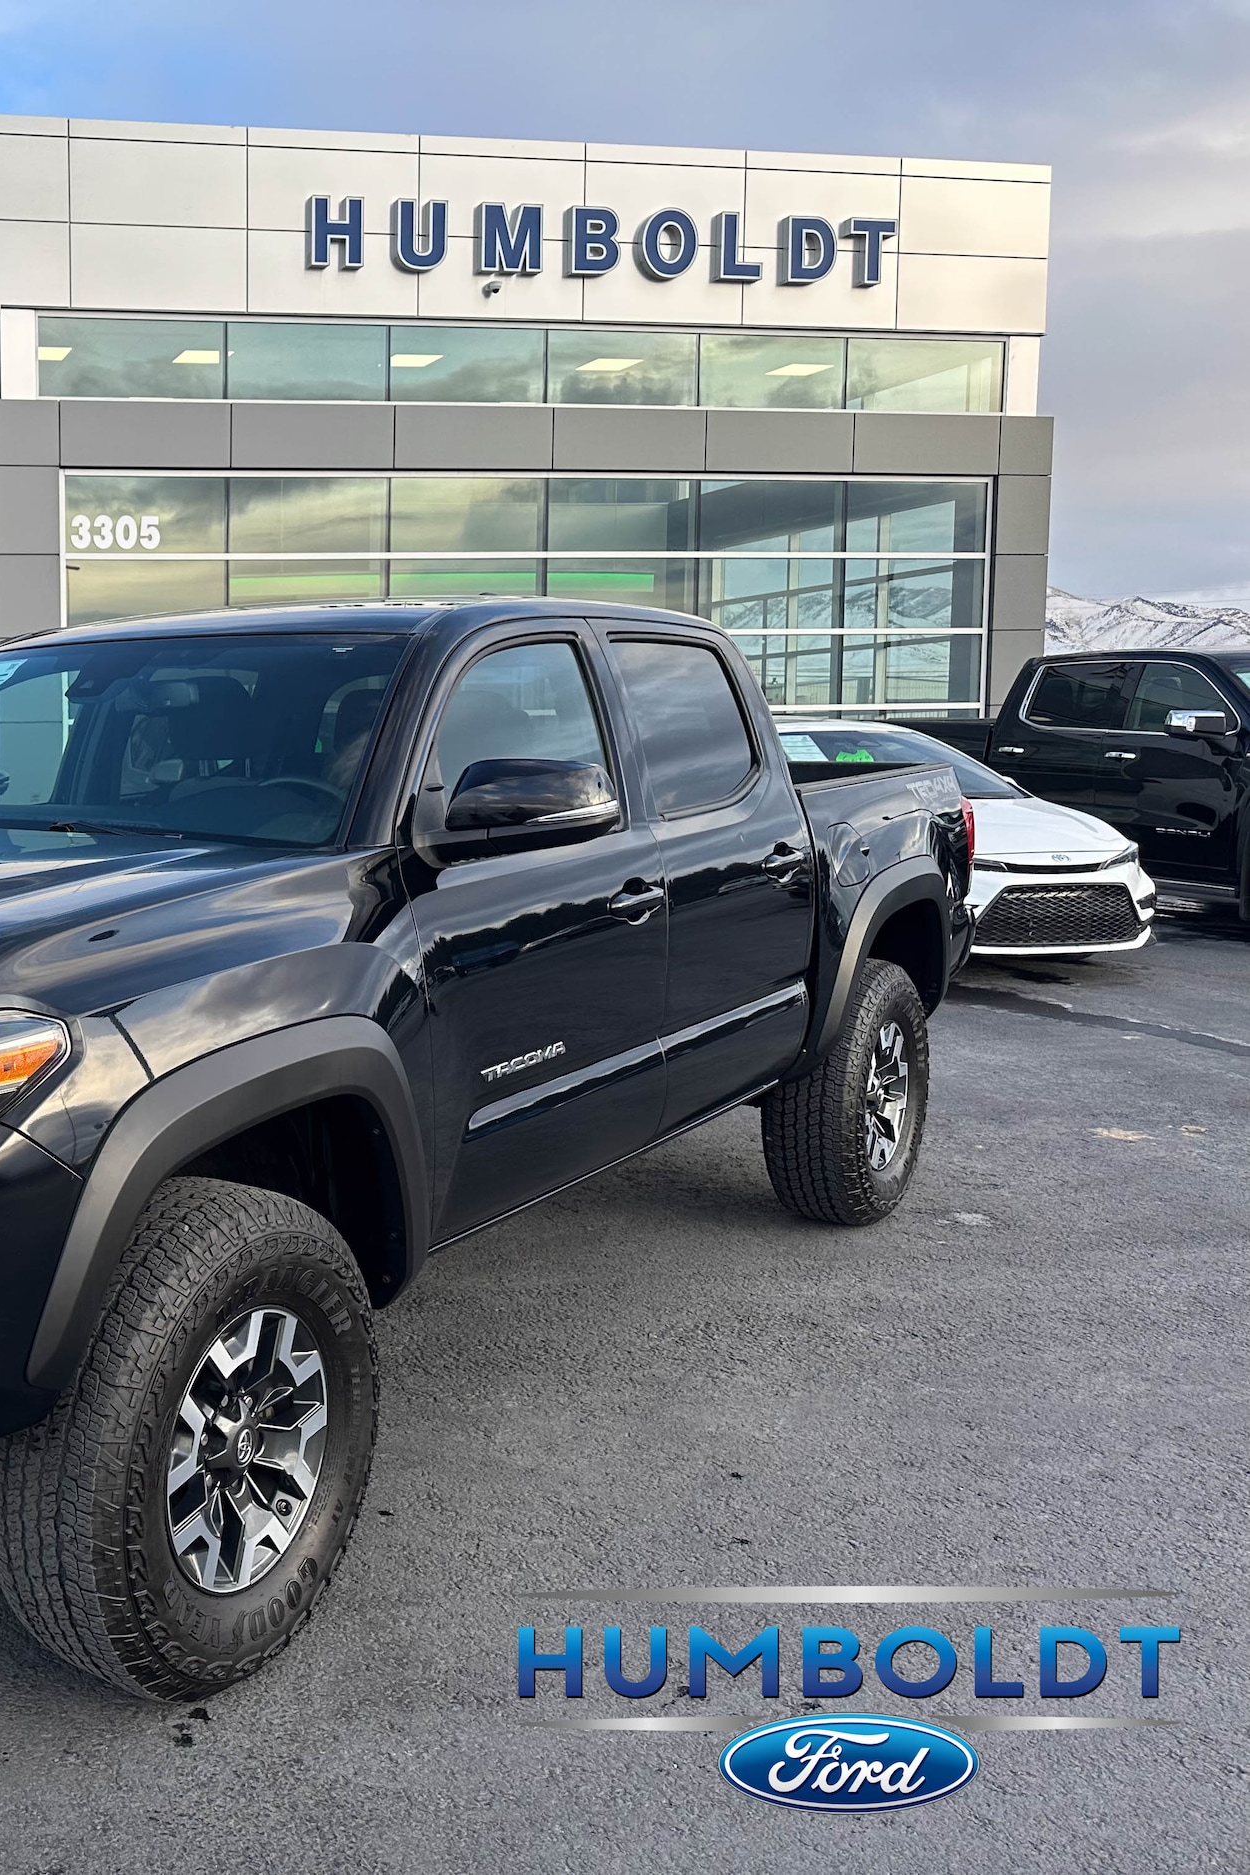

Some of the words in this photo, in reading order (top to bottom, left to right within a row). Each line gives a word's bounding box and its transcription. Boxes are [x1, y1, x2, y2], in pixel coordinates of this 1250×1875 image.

[307, 195, 899, 288] HUMBOLDT
[70, 514, 161, 550] 3305
[480, 1041, 566, 1082] TACOMA
